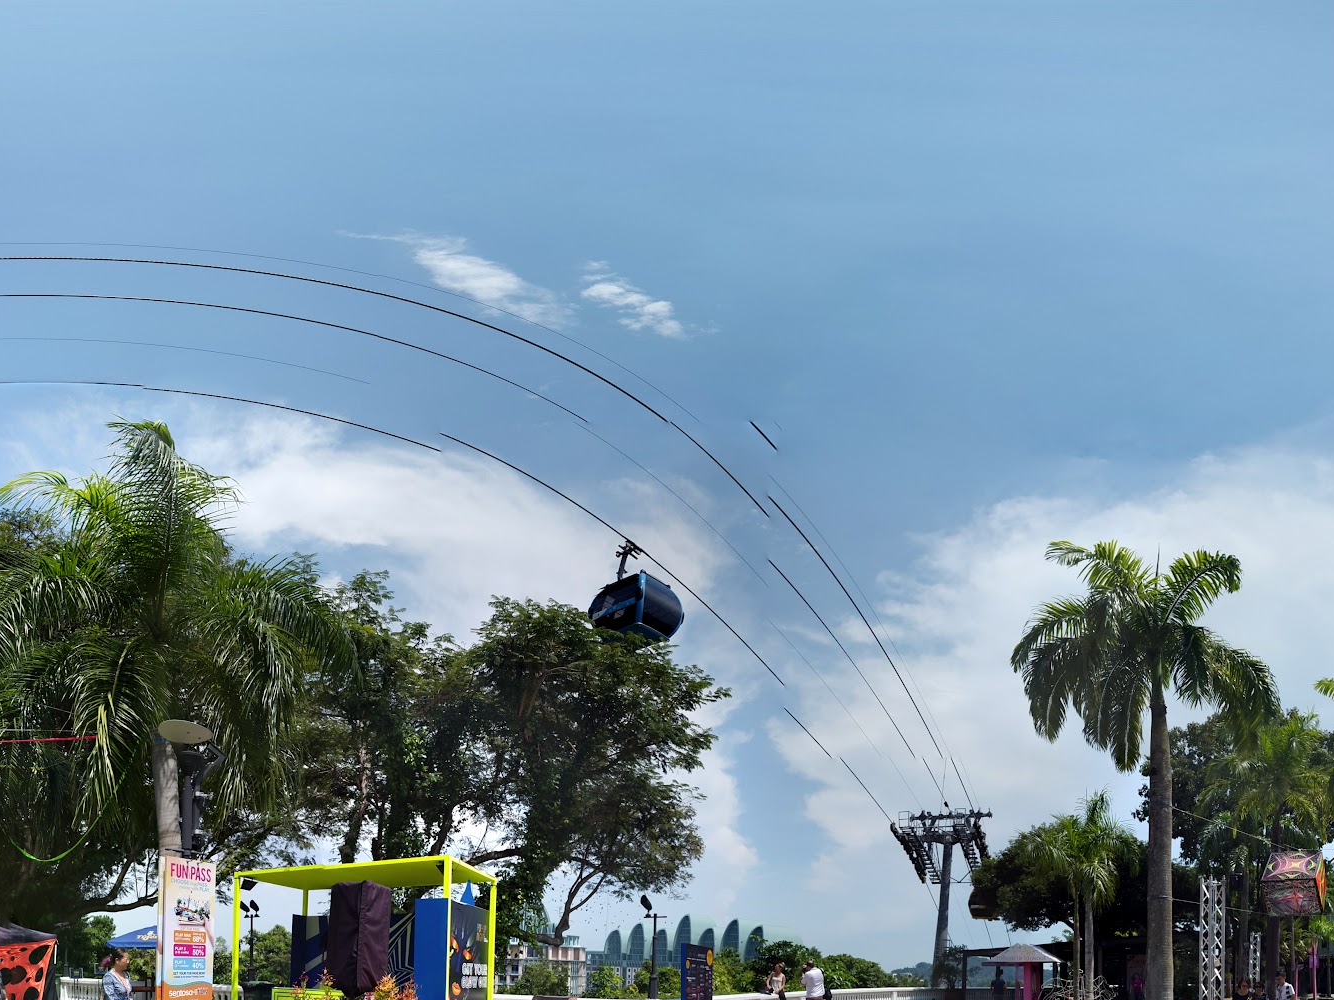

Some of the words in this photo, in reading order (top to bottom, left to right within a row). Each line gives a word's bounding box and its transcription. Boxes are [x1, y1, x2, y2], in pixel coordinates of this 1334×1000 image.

[170, 863, 189, 880] FUN
[190, 866, 212, 883] PASS
[168, 990, 193, 998] sentosa
